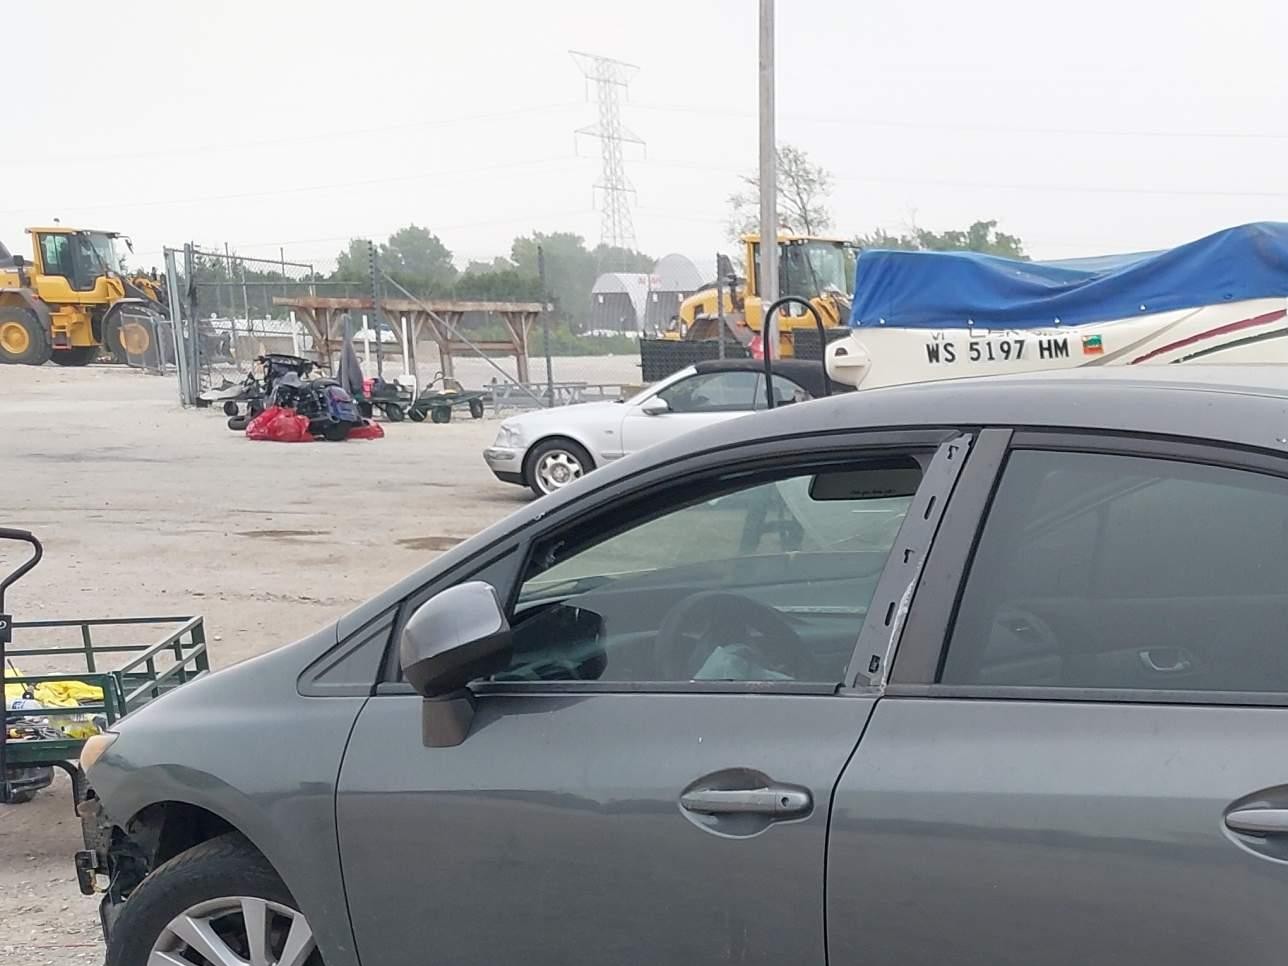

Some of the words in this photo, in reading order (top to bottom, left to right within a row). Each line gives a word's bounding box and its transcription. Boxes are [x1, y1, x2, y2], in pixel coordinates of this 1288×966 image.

[926, 343, 956, 363] WS
[969, 340, 1025, 362] 5197
[1038, 338, 1070, 359] HM
